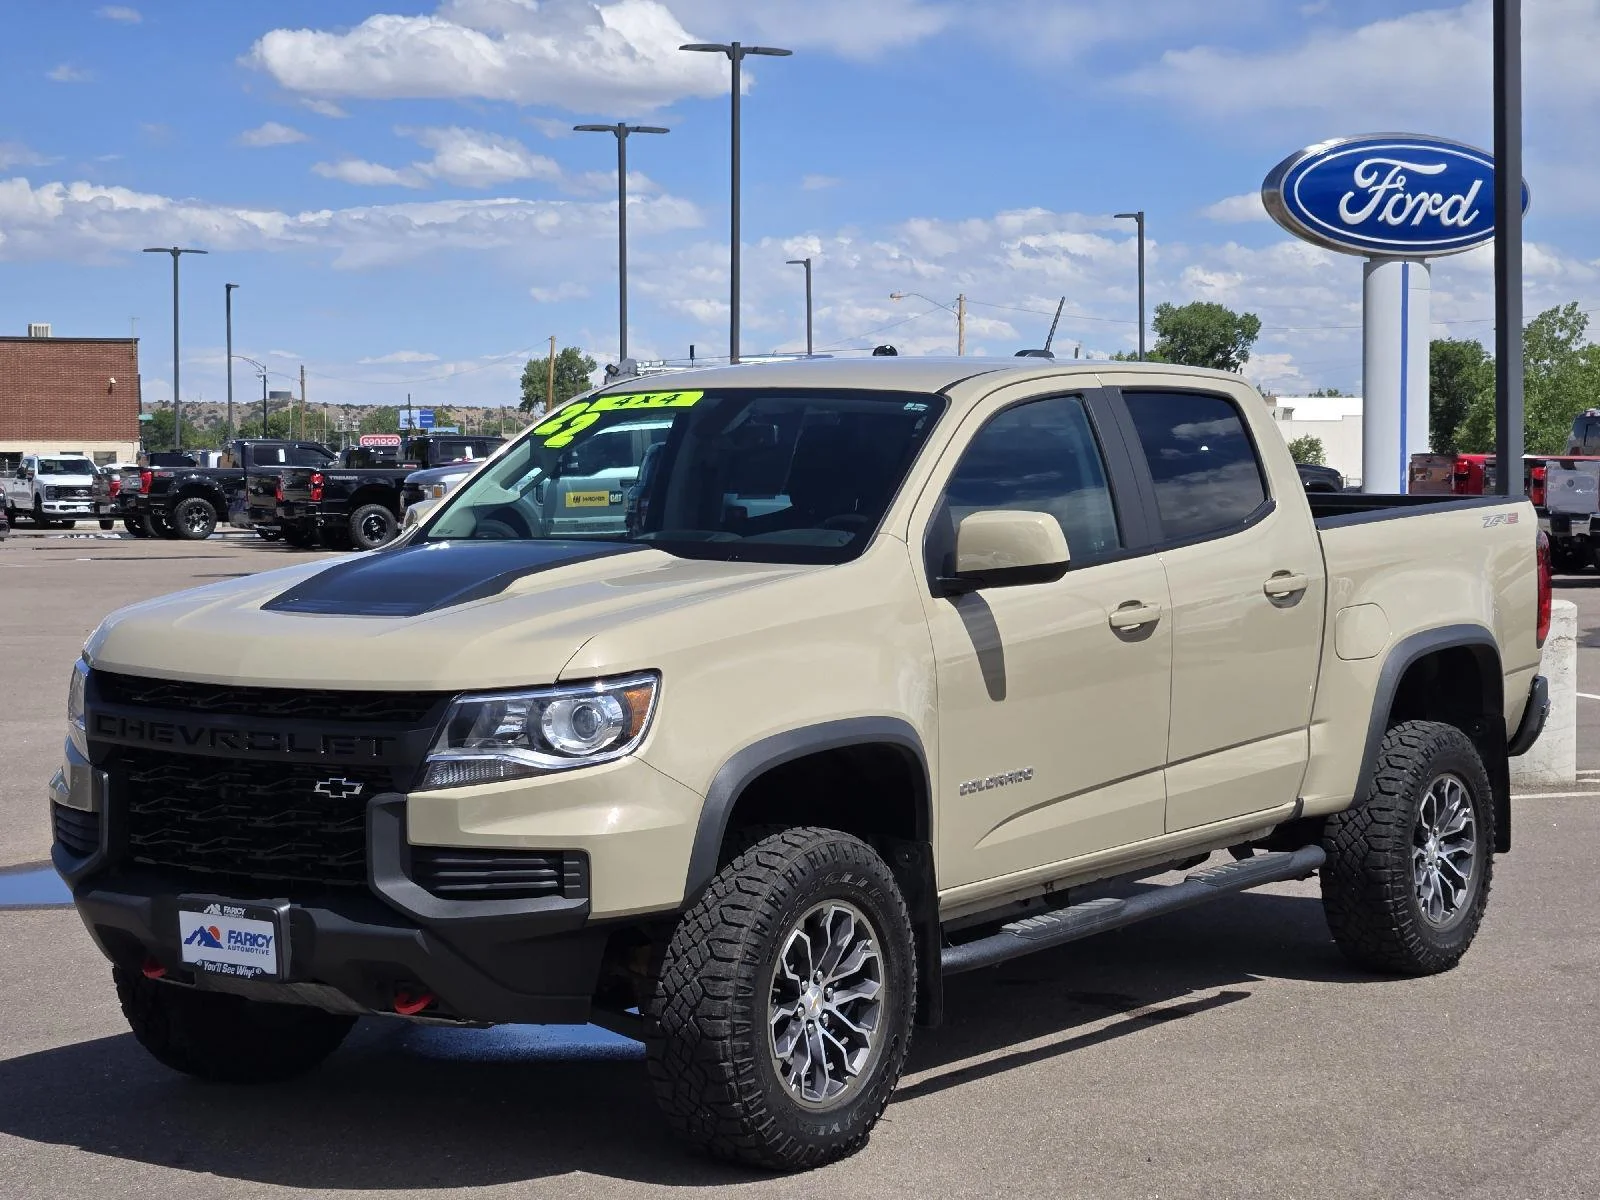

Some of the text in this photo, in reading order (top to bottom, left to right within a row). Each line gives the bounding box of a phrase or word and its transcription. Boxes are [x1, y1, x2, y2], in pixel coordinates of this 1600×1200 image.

[1338, 158, 1483, 227] Ford
[533, 402, 602, 448] 22
[95, 714, 397, 757] CHEVROLET
[959, 767, 1034, 796] COLORADO
[223, 905, 246, 915] FARICY
[227, 929, 273, 948] FARICY
[227, 944, 269, 955] AUTOMOTIVE
[203, 961, 255, 978] You'll See Why!
